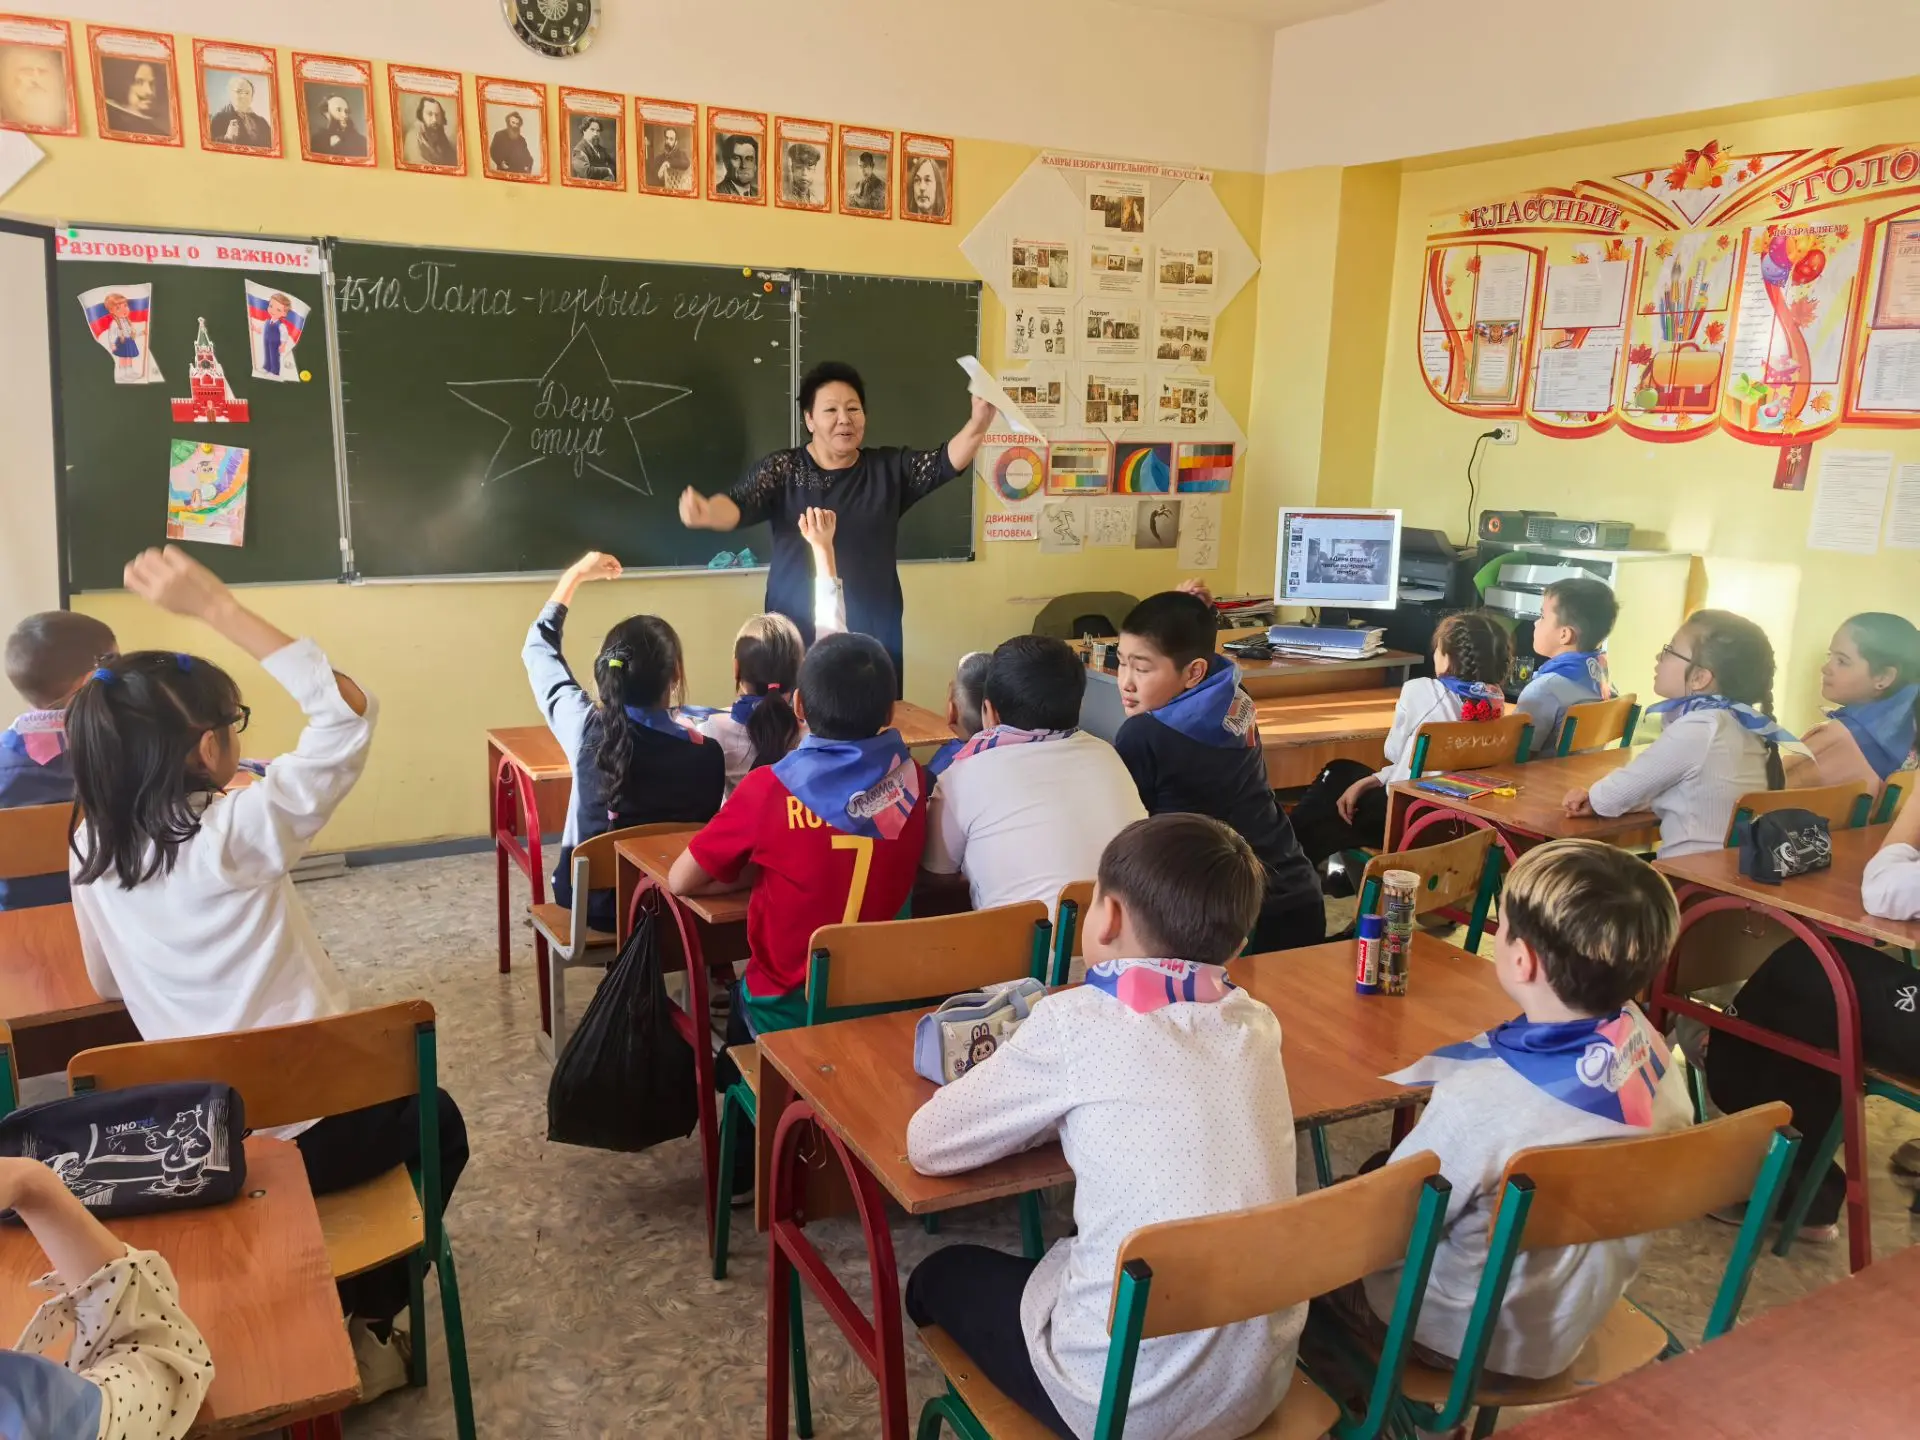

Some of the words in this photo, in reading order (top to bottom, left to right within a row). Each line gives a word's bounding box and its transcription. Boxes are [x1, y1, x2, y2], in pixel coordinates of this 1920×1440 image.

[1041, 156, 1072, 167] ЖАНРЫ
[1073, 158, 1159, 174] ИЗОБРАЗИТЕЛЬНОГО
[1470, 198, 1622, 230] КЛАССНЫЙ
[55, 235, 181, 264] Разговоры
[187, 242, 200, 259] о
[216, 244, 309, 268] важном:
[403, 260, 517, 316] Папа
[538, 274, 658, 337] первый
[673, 291, 764, 341] герой
[533, 380, 614, 422] День
[530, 426, 607, 479] отца
[985, 514, 1034, 524] ДВИЖЕНИЕ
[986, 529, 1032, 538] ЧЕЛОВЕКА
[831, 834, 874, 925] 7
